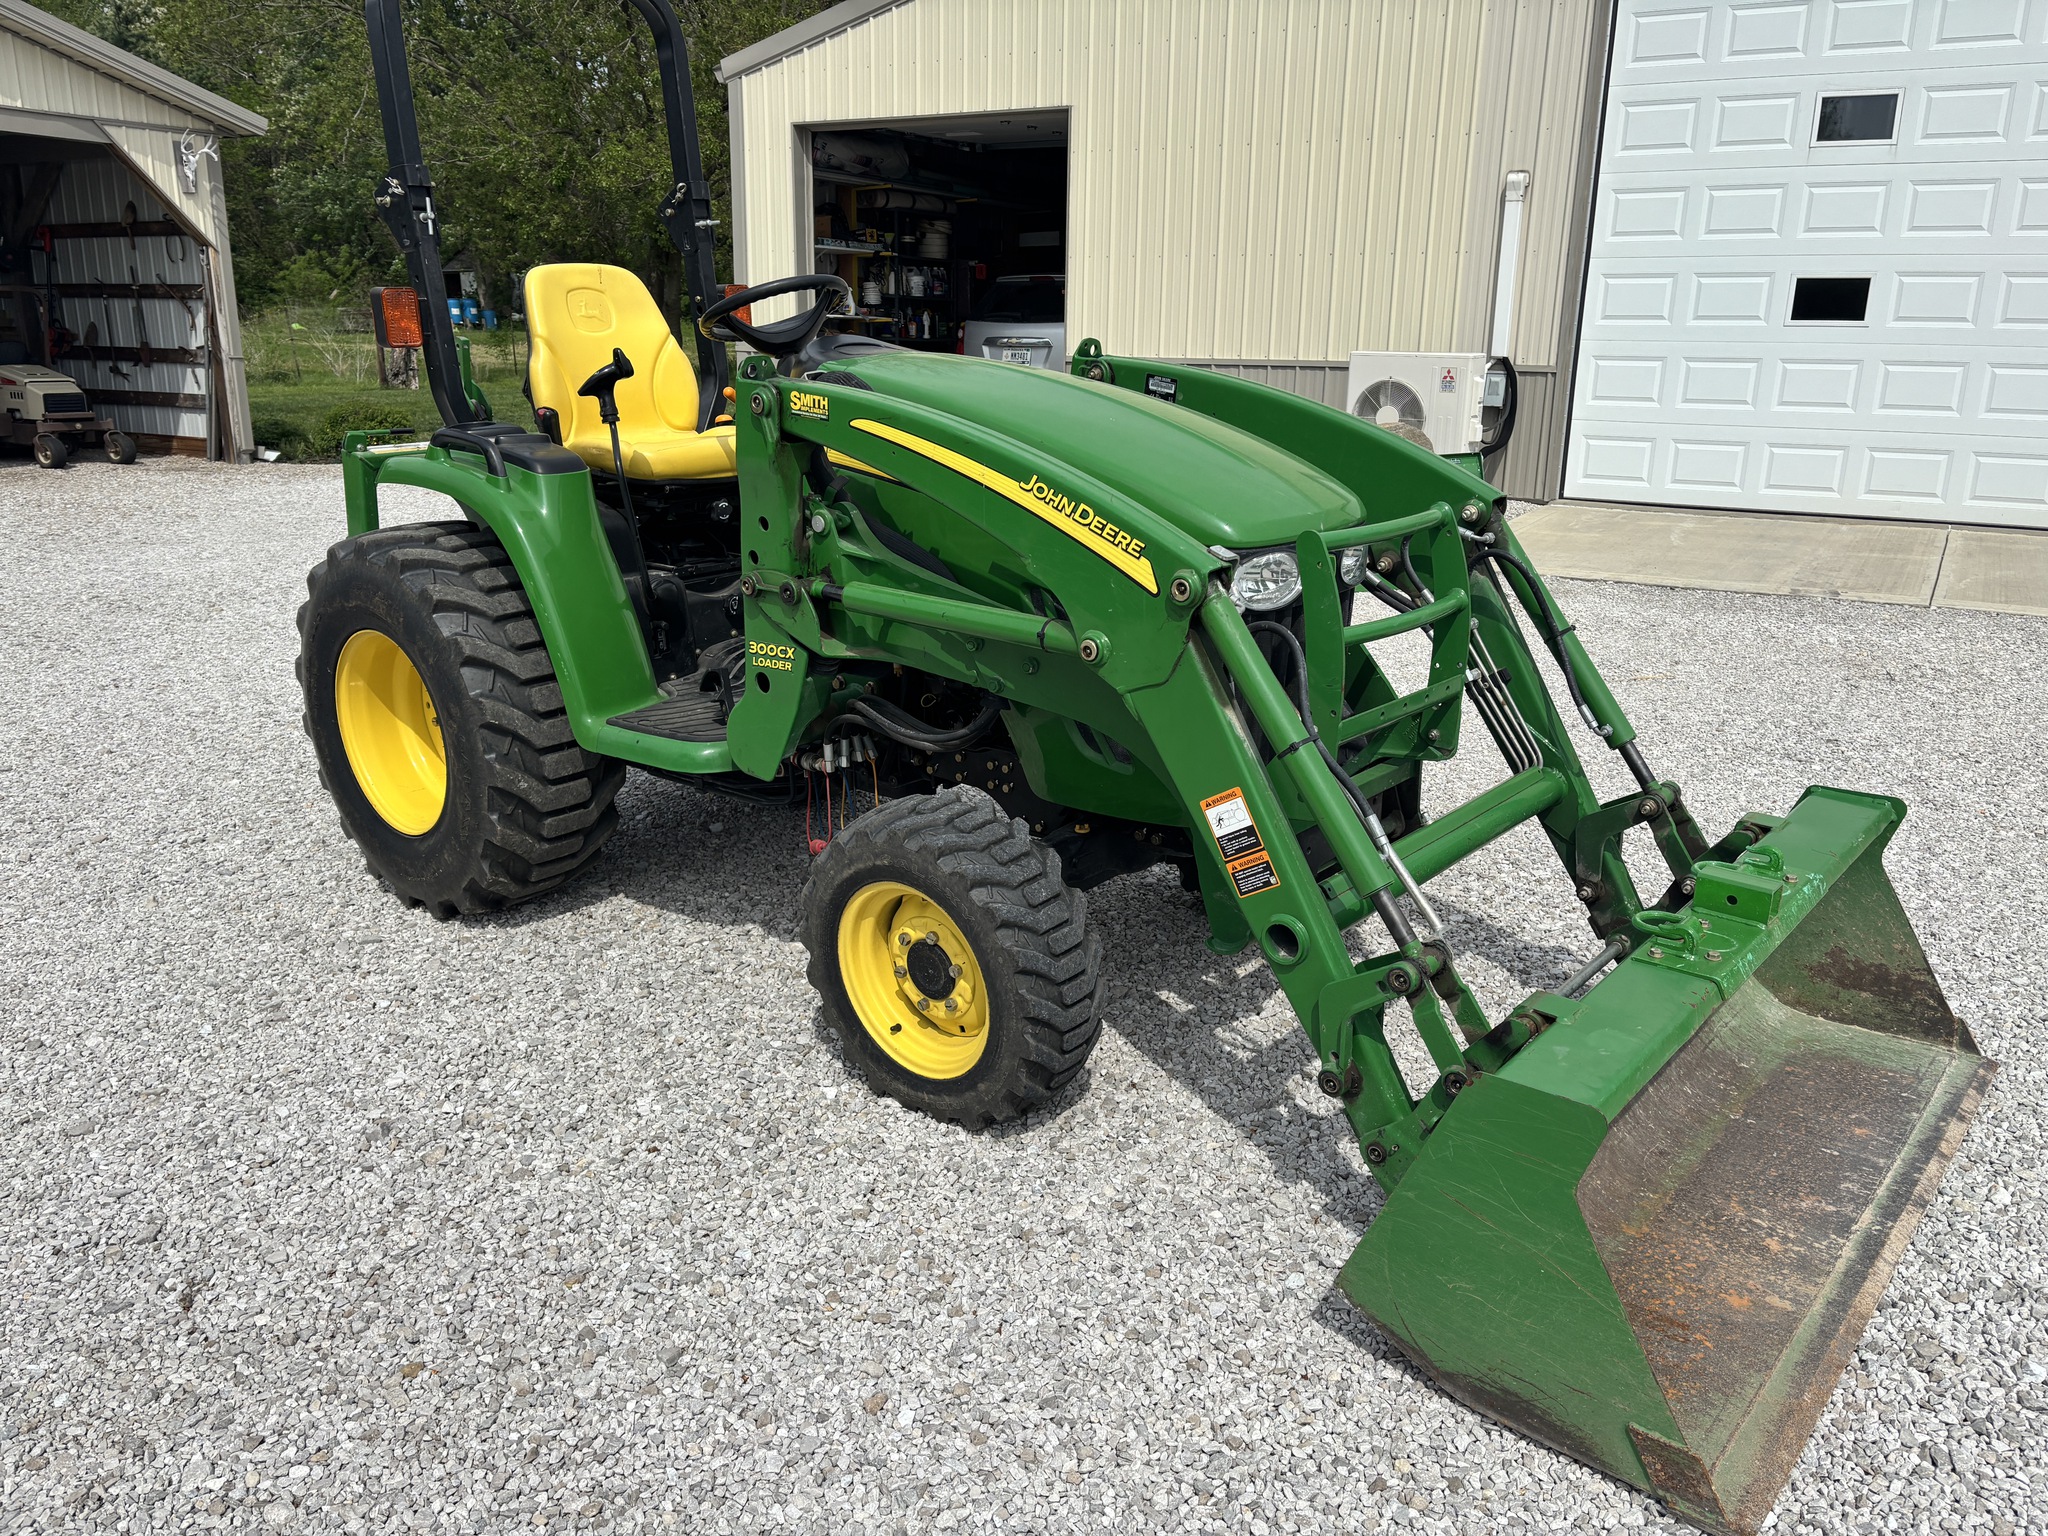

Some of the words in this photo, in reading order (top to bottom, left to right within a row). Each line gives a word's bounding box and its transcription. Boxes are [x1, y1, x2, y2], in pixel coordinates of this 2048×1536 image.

[790, 390, 828, 410] SMITH
[1019, 474, 1076, 516] JOHN
[1072, 502, 1146, 558] DEERE
[748, 641, 796, 660] 300CX
[752, 656, 792, 671] LOADER
[1211, 791, 1237, 806] WARNING
[1238, 854, 1265, 868] WARNING
